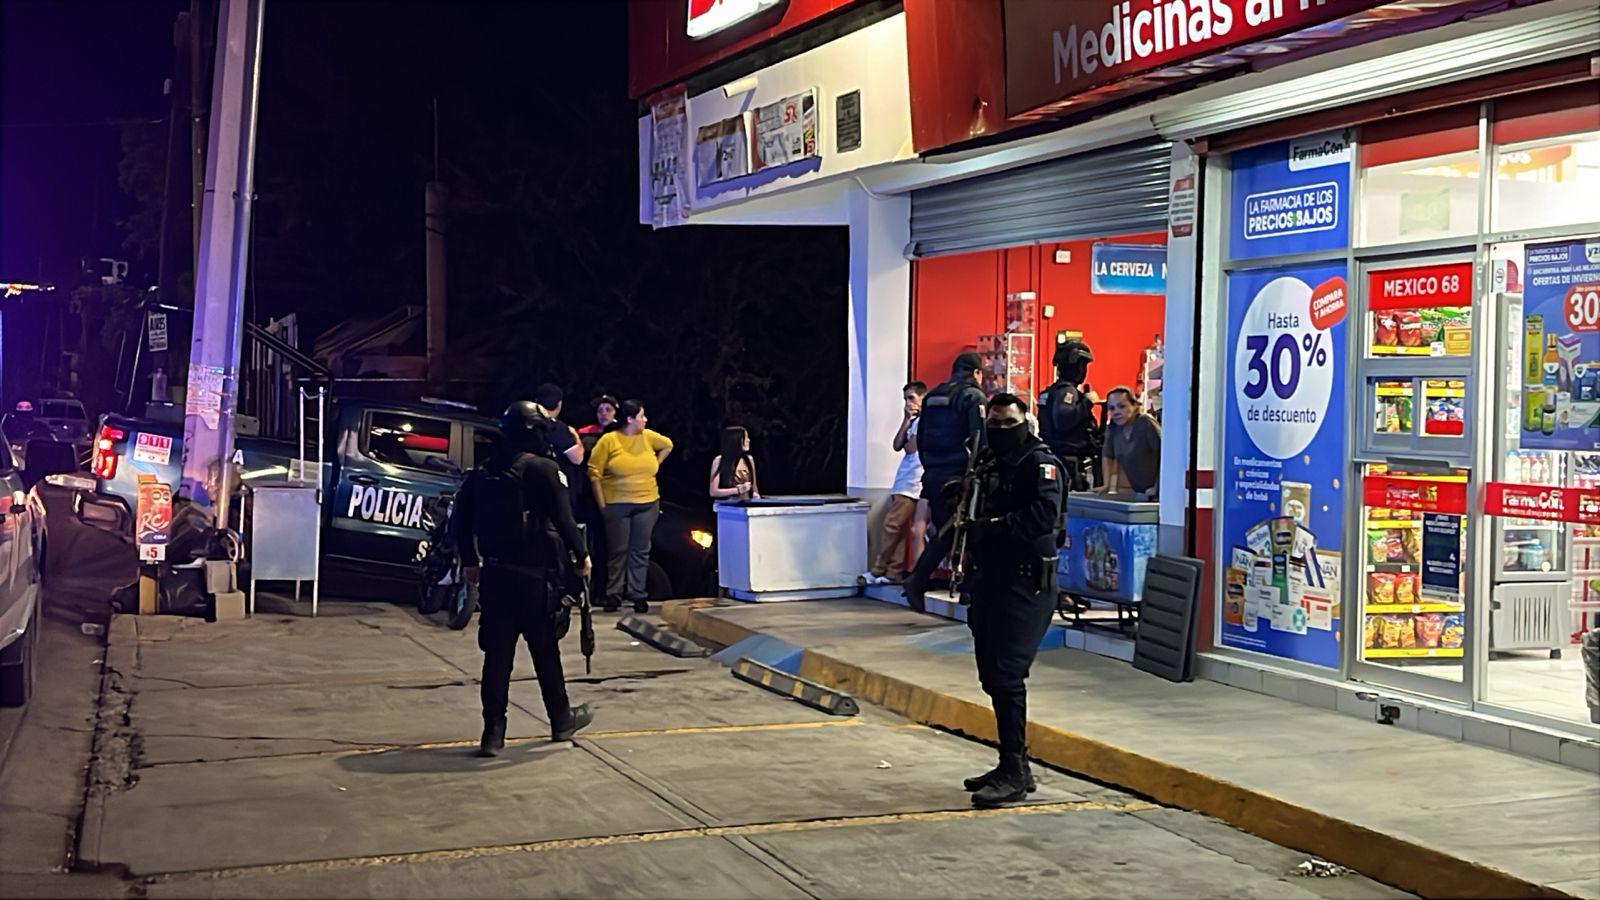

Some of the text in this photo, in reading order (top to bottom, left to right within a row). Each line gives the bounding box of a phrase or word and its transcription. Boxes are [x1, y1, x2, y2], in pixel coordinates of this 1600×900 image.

[1052, 0, 1233, 84] Medicinas
[1249, 189, 1333, 215] LA FARMACIA DE LOS
[1248, 206, 1333, 234] PRECIOS BAJOS
[1094, 261, 1108, 276] LA
[1110, 261, 1154, 278] CERVEZA
[1532, 276, 1560, 286] OFERTAS
[1561, 275, 1570, 284] DE
[1384, 274, 1460, 298] MEXICO 68
[1312, 287, 1344, 311] COMPARA
[1268, 313, 1300, 331] Hasta
[1243, 333, 1327, 400] 30%
[1247, 404, 1317, 424] de descuento
[139, 434, 169, 448] 911
[138, 512, 170, 532] RC
